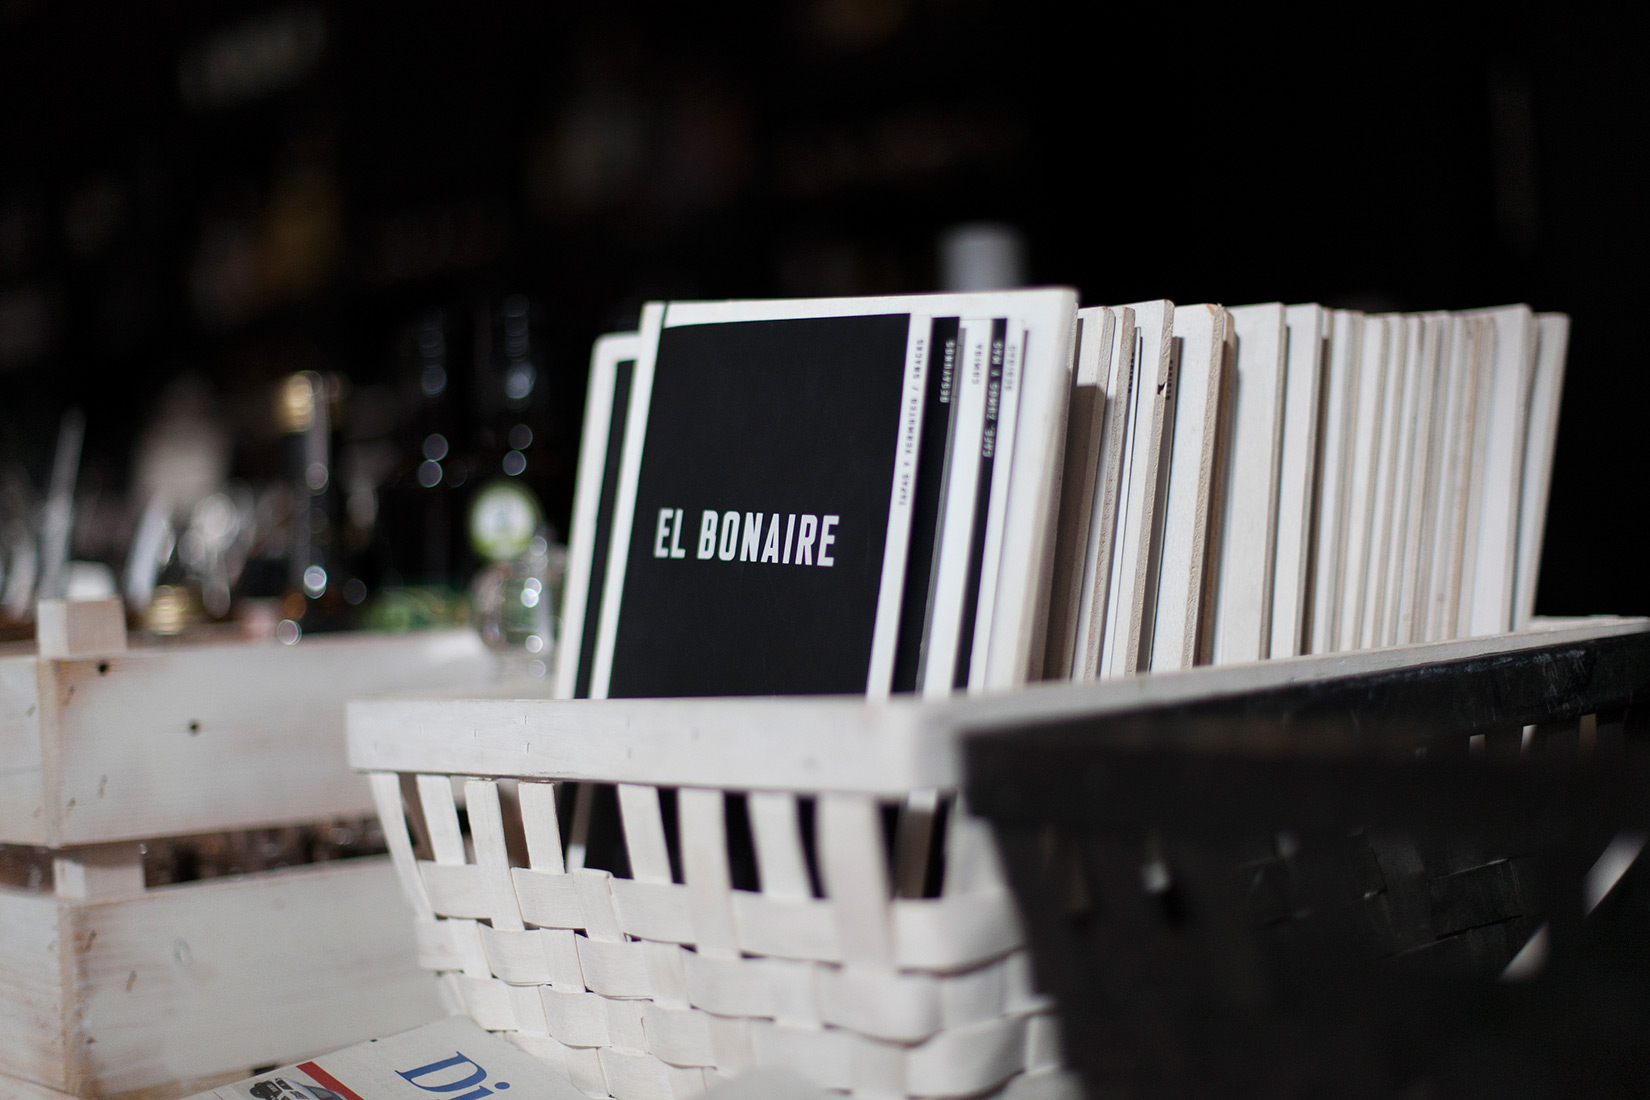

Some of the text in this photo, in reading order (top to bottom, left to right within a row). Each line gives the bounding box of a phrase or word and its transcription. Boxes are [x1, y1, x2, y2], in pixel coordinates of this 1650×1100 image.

[912, 338, 924, 379] SNACKS
[939, 339, 956, 404] DESAYUNOS
[971, 342, 984, 386] COMIDA
[986, 381, 1001, 421] ZUMOS
[653, 507, 840, 567] EL BONAIRE
